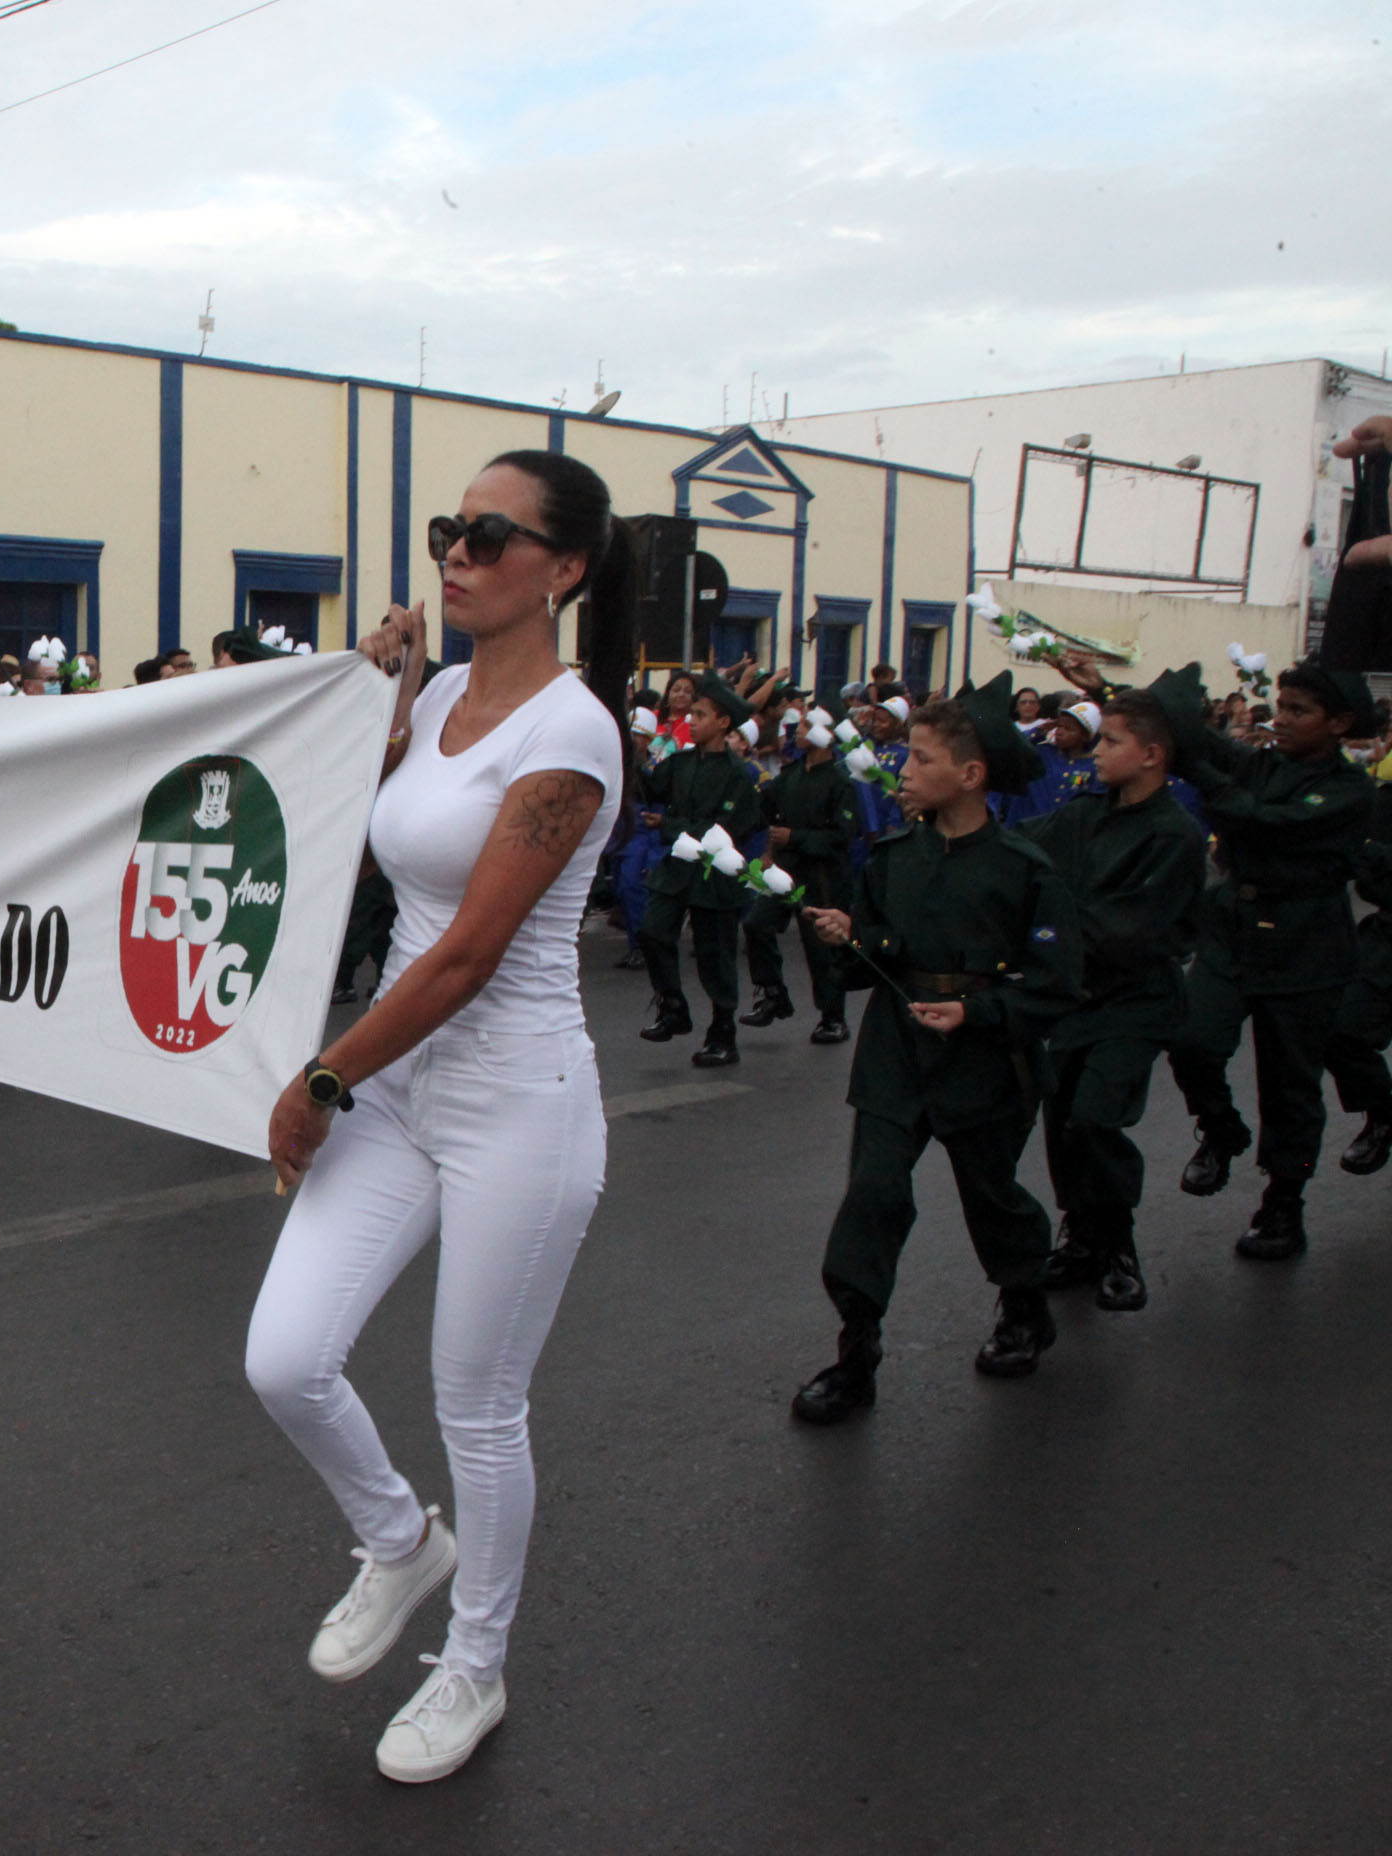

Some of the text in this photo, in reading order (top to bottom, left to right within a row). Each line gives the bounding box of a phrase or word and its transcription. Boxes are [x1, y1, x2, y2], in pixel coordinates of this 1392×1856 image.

[130, 841, 281, 945] 155 Anos
[176, 937, 253, 1027] VG
[155, 1023, 196, 1046] 2022
